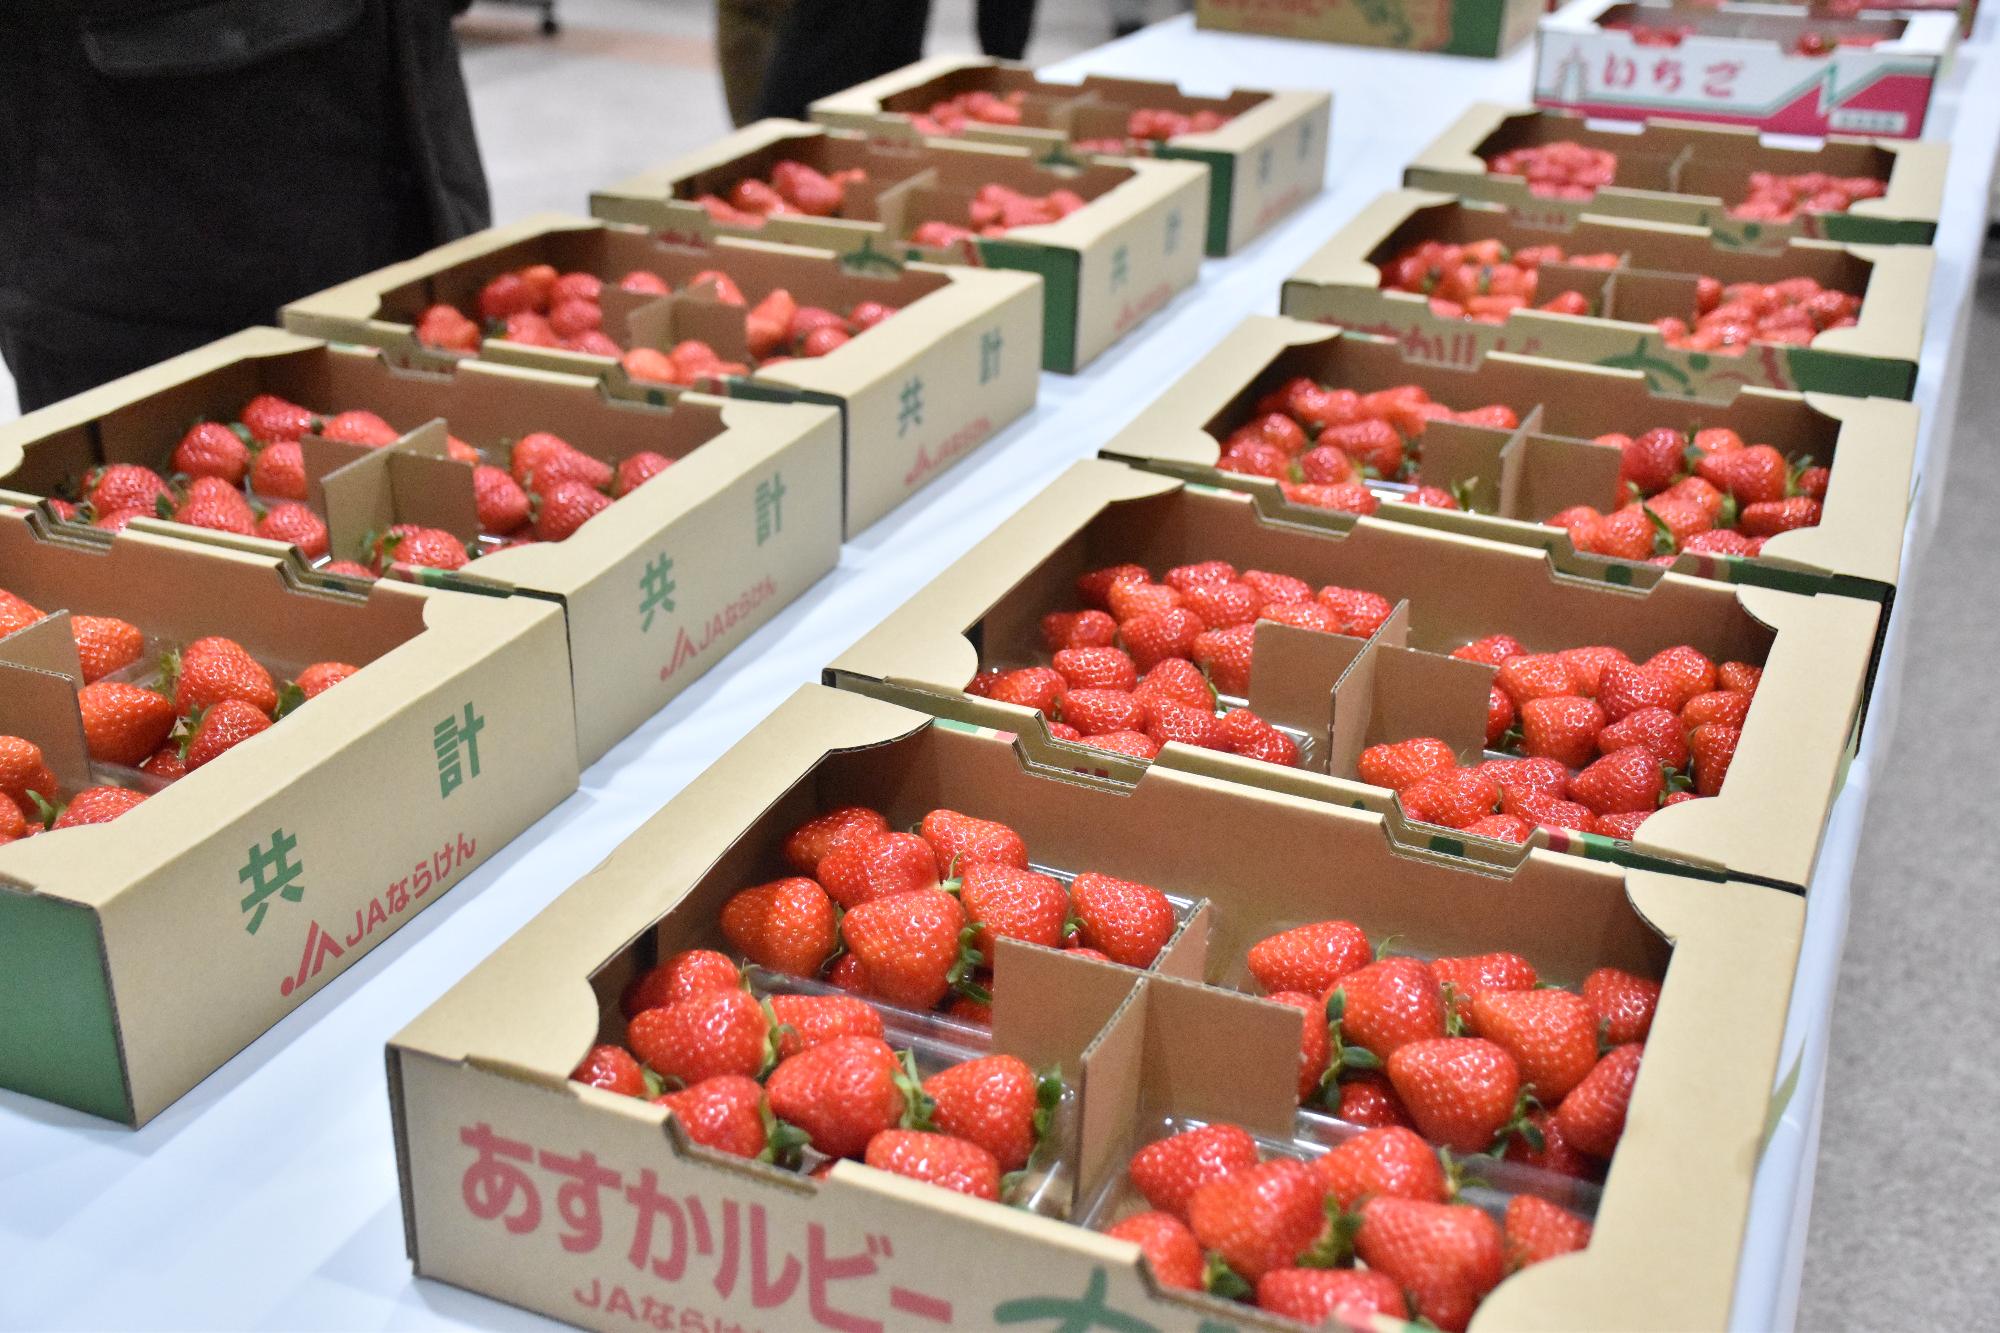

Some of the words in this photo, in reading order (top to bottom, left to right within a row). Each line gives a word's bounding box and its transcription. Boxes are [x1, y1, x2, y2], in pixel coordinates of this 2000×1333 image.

[1603, 53, 1744, 98] いちご
[639, 551, 676, 633] 共
[755, 471, 785, 546] 計
[238, 827, 305, 936] 共
[433, 701, 485, 800] 計
[345, 832, 477, 948] JAならけん
[459, 1122, 953, 1333] あすかルビー
[573, 1278, 765, 1333] JAなら
